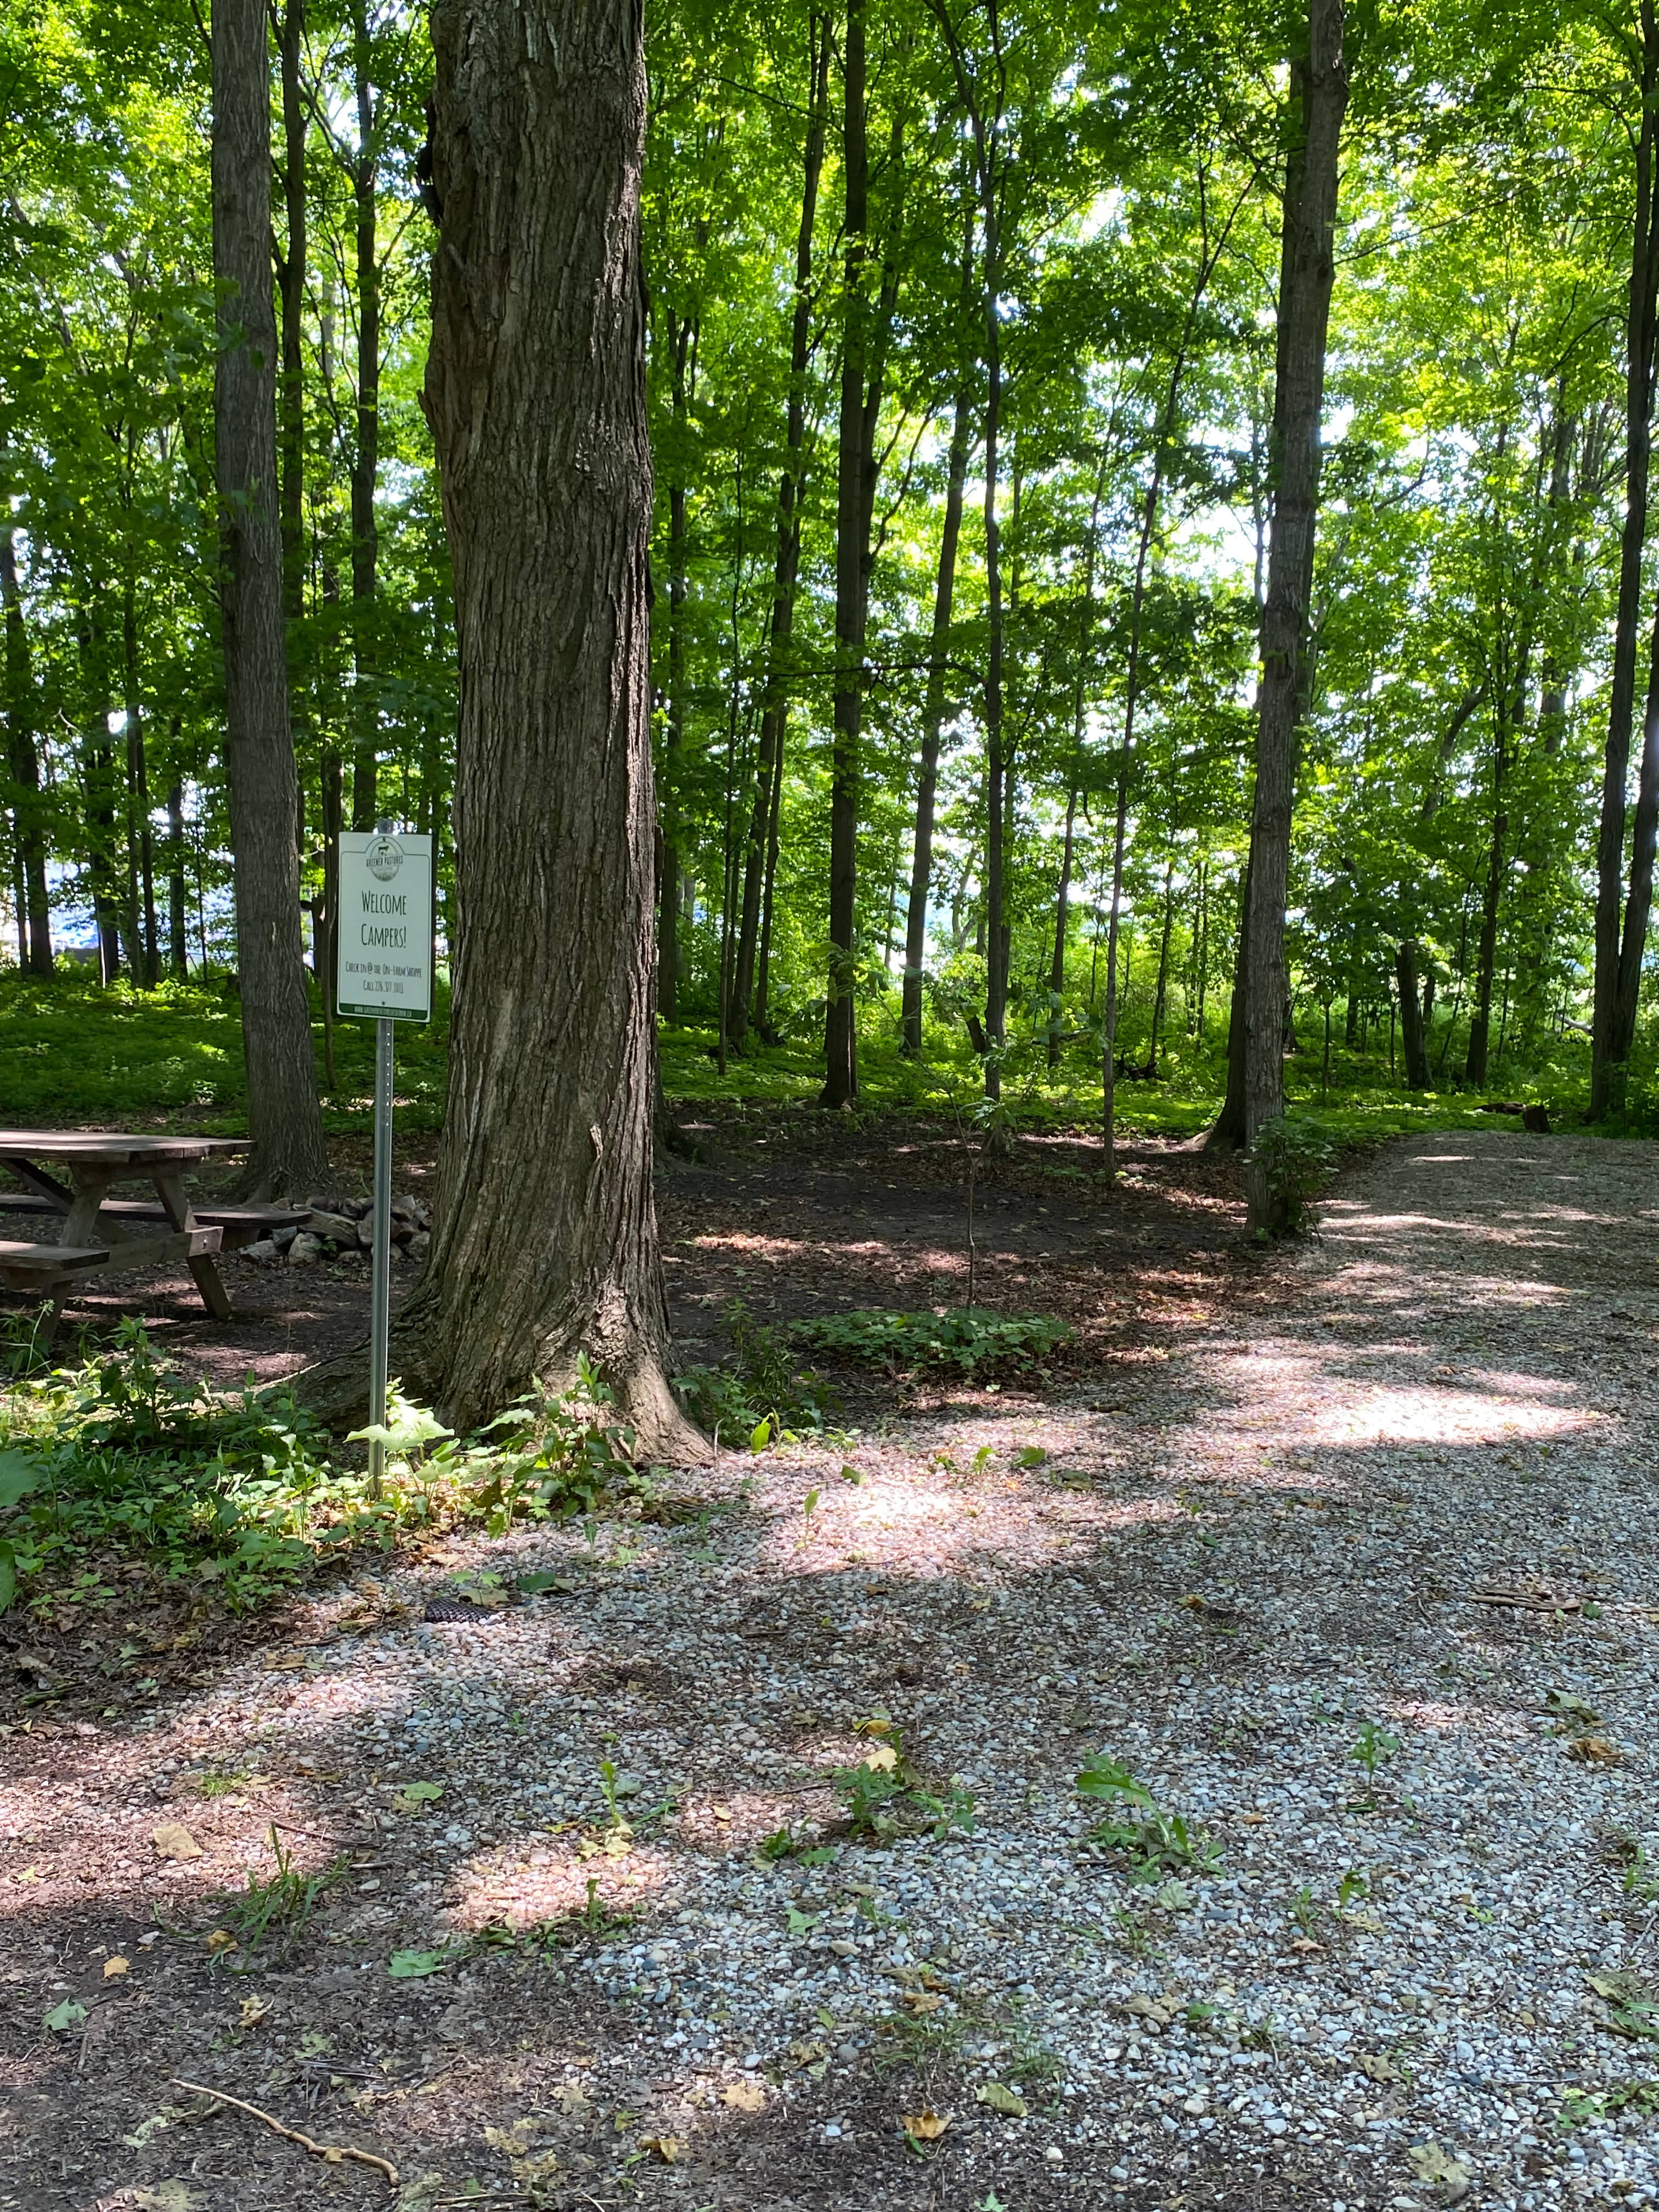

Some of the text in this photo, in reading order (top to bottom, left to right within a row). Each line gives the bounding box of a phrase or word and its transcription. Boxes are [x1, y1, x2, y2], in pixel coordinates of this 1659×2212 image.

[362, 890, 407, 916] WELCOME
[361, 923, 407, 948] CAMPERS!
[363, 979, 374, 991] CALL
